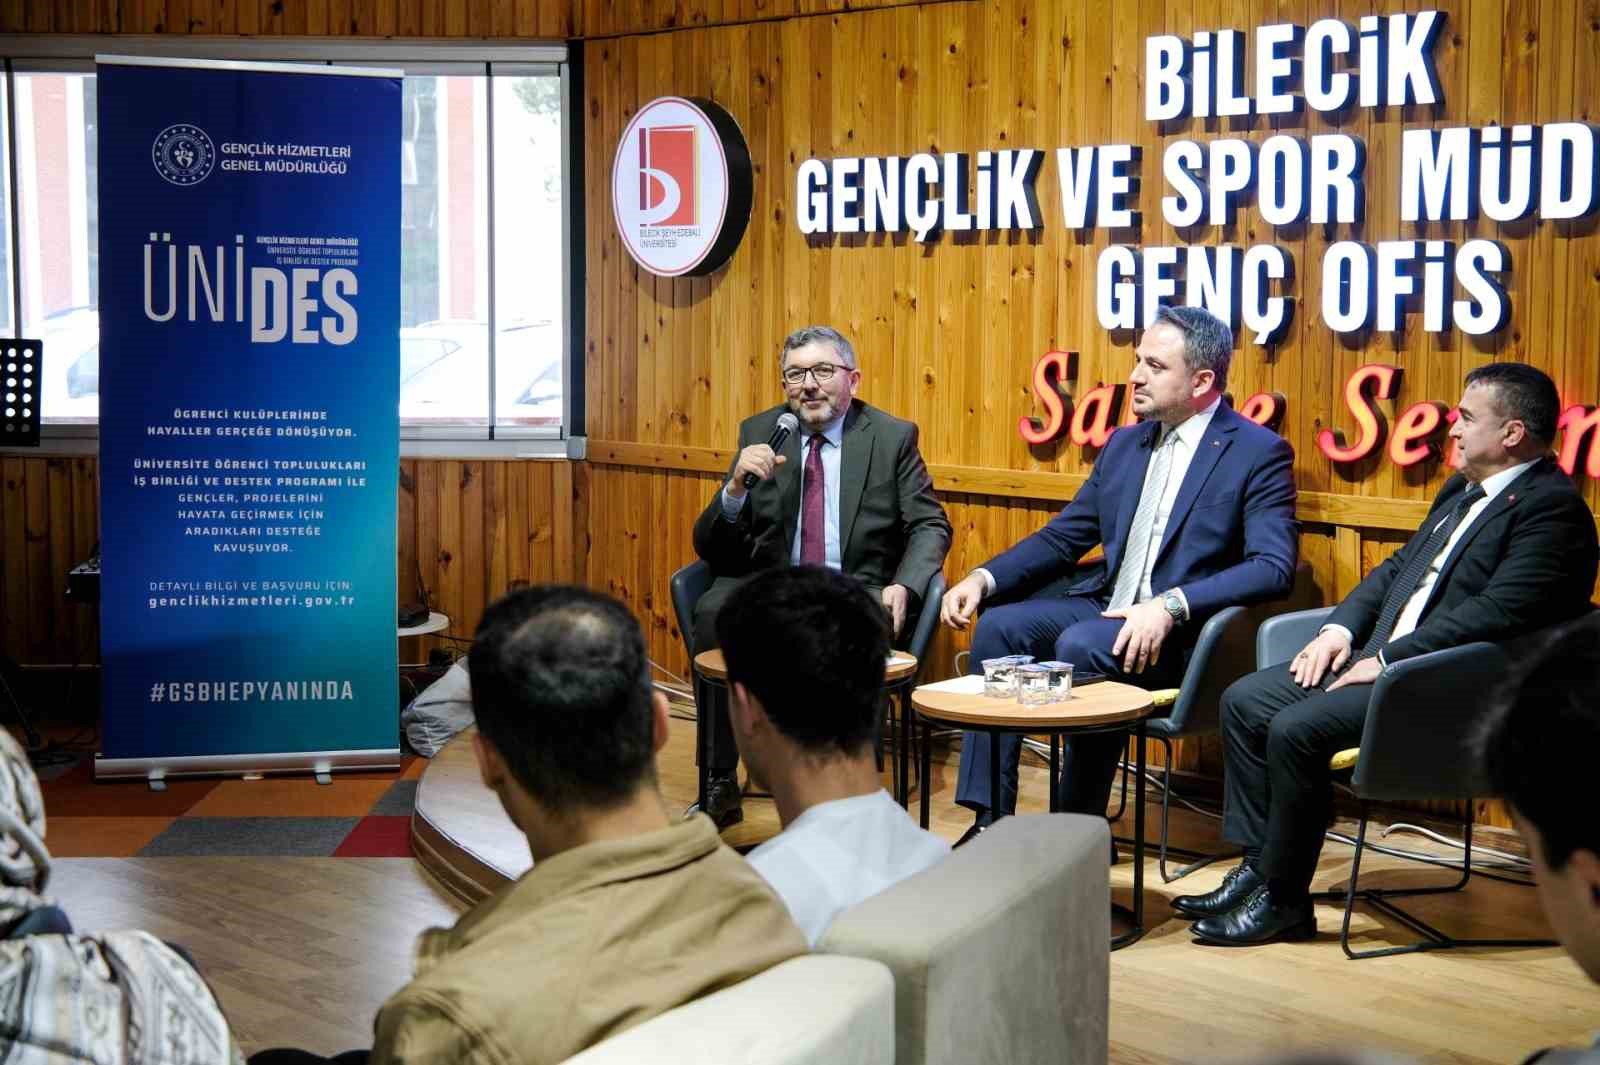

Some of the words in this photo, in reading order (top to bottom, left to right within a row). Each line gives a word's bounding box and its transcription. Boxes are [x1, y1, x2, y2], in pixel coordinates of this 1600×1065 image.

[1146, 11, 1438, 120] BİLECİK
[221, 142, 275, 157] GENÇLİK
[277, 143, 352, 158] HİZMETLERİ
[221, 160, 262, 172] GENEL
[264, 160, 347, 174] MÜDÜRLÜĞÜ
[797, 149, 1034, 242] GENÇLİK
[1056, 145, 1132, 229] VE
[1162, 134, 1356, 228] SPOR
[1401, 122, 1594, 221] MÜD
[1097, 244, 1285, 345] GENÇ
[1322, 239, 1503, 335] OFİS
[233, 409, 327, 420] KULÜPLERİNDE
[1019, 351, 1276, 448] Sae
[1318, 363, 1600, 480] Sen
[147, 426, 211, 436] HAYALLER
[216, 425, 272, 438] GERÇEĞE
[276, 426, 357, 438] DÖNÜŞÜYOR.
[133, 458, 209, 469] ÜNİVERSİTE
[214, 458, 269, 470] ÖĞRENCİ
[273, 460, 366, 471] TOPLULUKLARI
[133, 475, 147, 487] İŞ
[151, 475, 199, 486] BİRLİĞİ
[203, 476, 220, 486] VE
[224, 477, 272, 486] DESTEK
[276, 477, 342, 487] PROGRAMI
[346, 476, 366, 487] İLE
[178, 493, 239, 504] GENÇLER,
[243, 493, 323, 503] PROJELERİNİ
[178, 510, 226, 519] HAYATA
[230, 509, 294, 521] GEÇİRMEK
[298, 509, 324, 521] İÇİN
[185, 527, 261, 536] ARADIKLARI
[266, 525, 321, 536] DESTEĞE
[213, 543, 293, 555] KAVUŞUYOR.
[150, 581, 200, 591] DETAYLI
[242, 581, 257, 591] VE
[262, 581, 321, 592] BAŞVURU
[149, 595, 355, 609] genclikhizmetleri.gov.tr
[150, 680, 353, 702] #GSBHEPYANINDA
